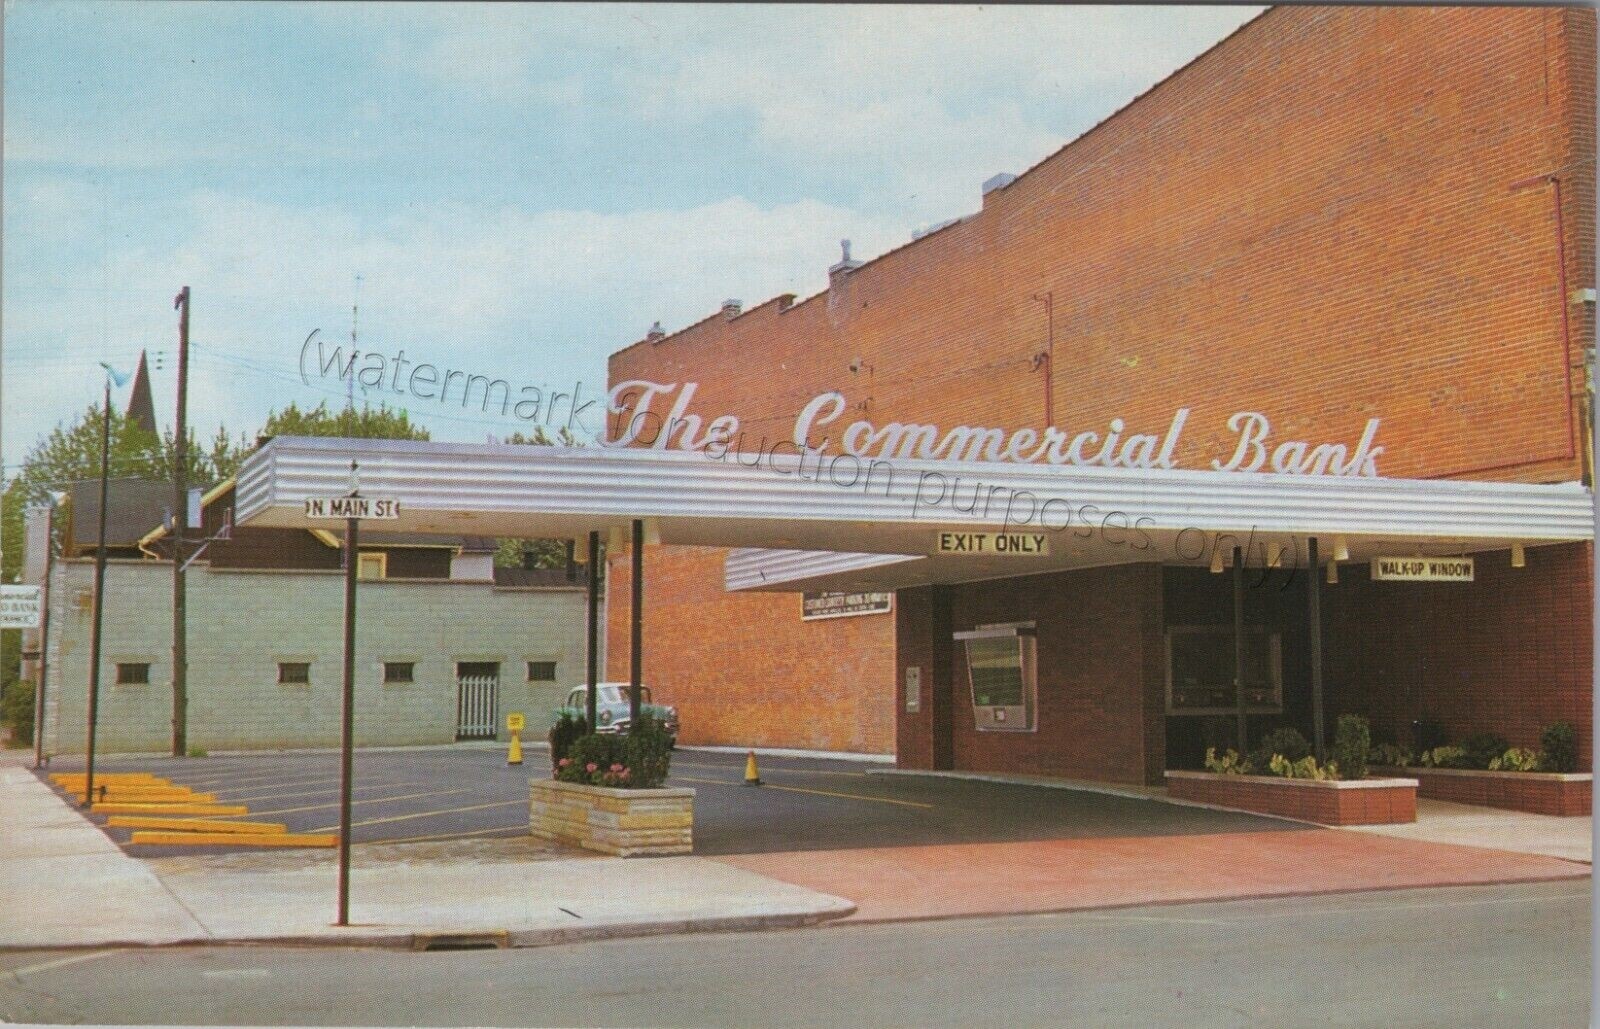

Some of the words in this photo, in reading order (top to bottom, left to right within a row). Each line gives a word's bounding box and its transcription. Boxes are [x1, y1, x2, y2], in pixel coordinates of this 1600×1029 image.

[597, 379, 740, 450] The
[794, 391, 1189, 470] Commercial
[1211, 411, 1385, 478] Bank
[330, 499, 369, 516] MAIN
[941, 534, 985, 551] EXIT
[995, 535, 1045, 552] ONLY
[1380, 562, 1424, 576] WALK-UP
[1429, 562, 1471, 577] WINDOW
